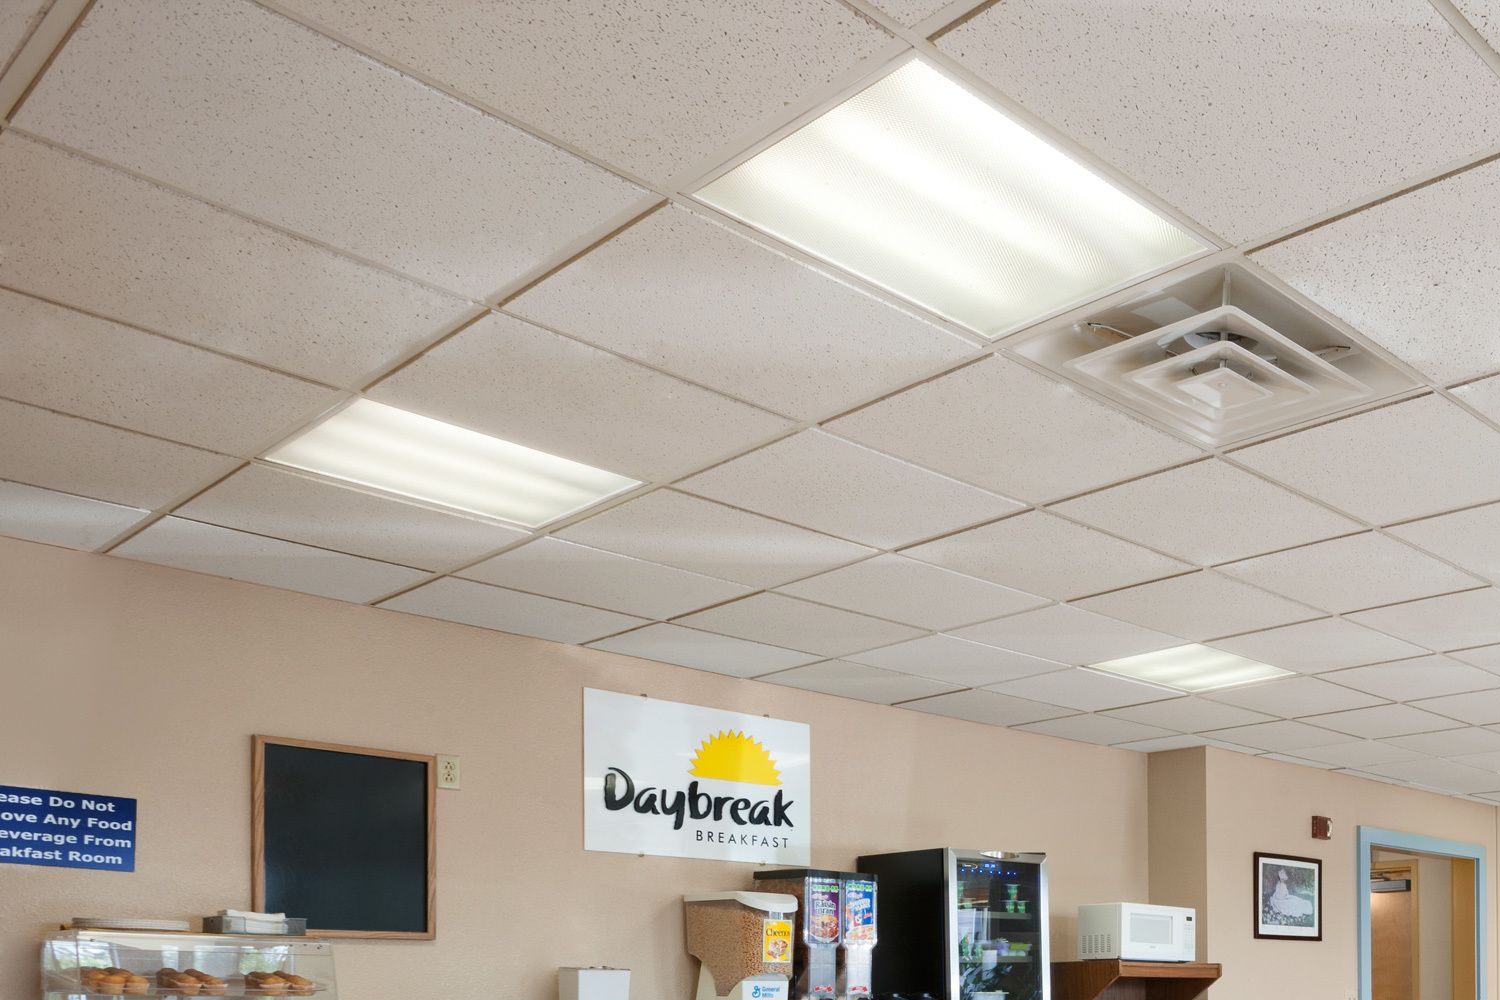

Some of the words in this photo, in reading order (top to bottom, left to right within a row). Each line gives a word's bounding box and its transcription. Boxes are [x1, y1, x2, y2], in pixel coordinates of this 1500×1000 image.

[49, 796, 75, 809] Do
[81, 799, 116, 813] Not
[604, 767, 794, 830] Daybreak
[43, 813, 81, 829] Any
[87, 817, 133, 831] Food
[83, 834, 132, 848] From
[696, 830, 789, 849] BREAKFAST
[68, 850, 123, 865] Room
